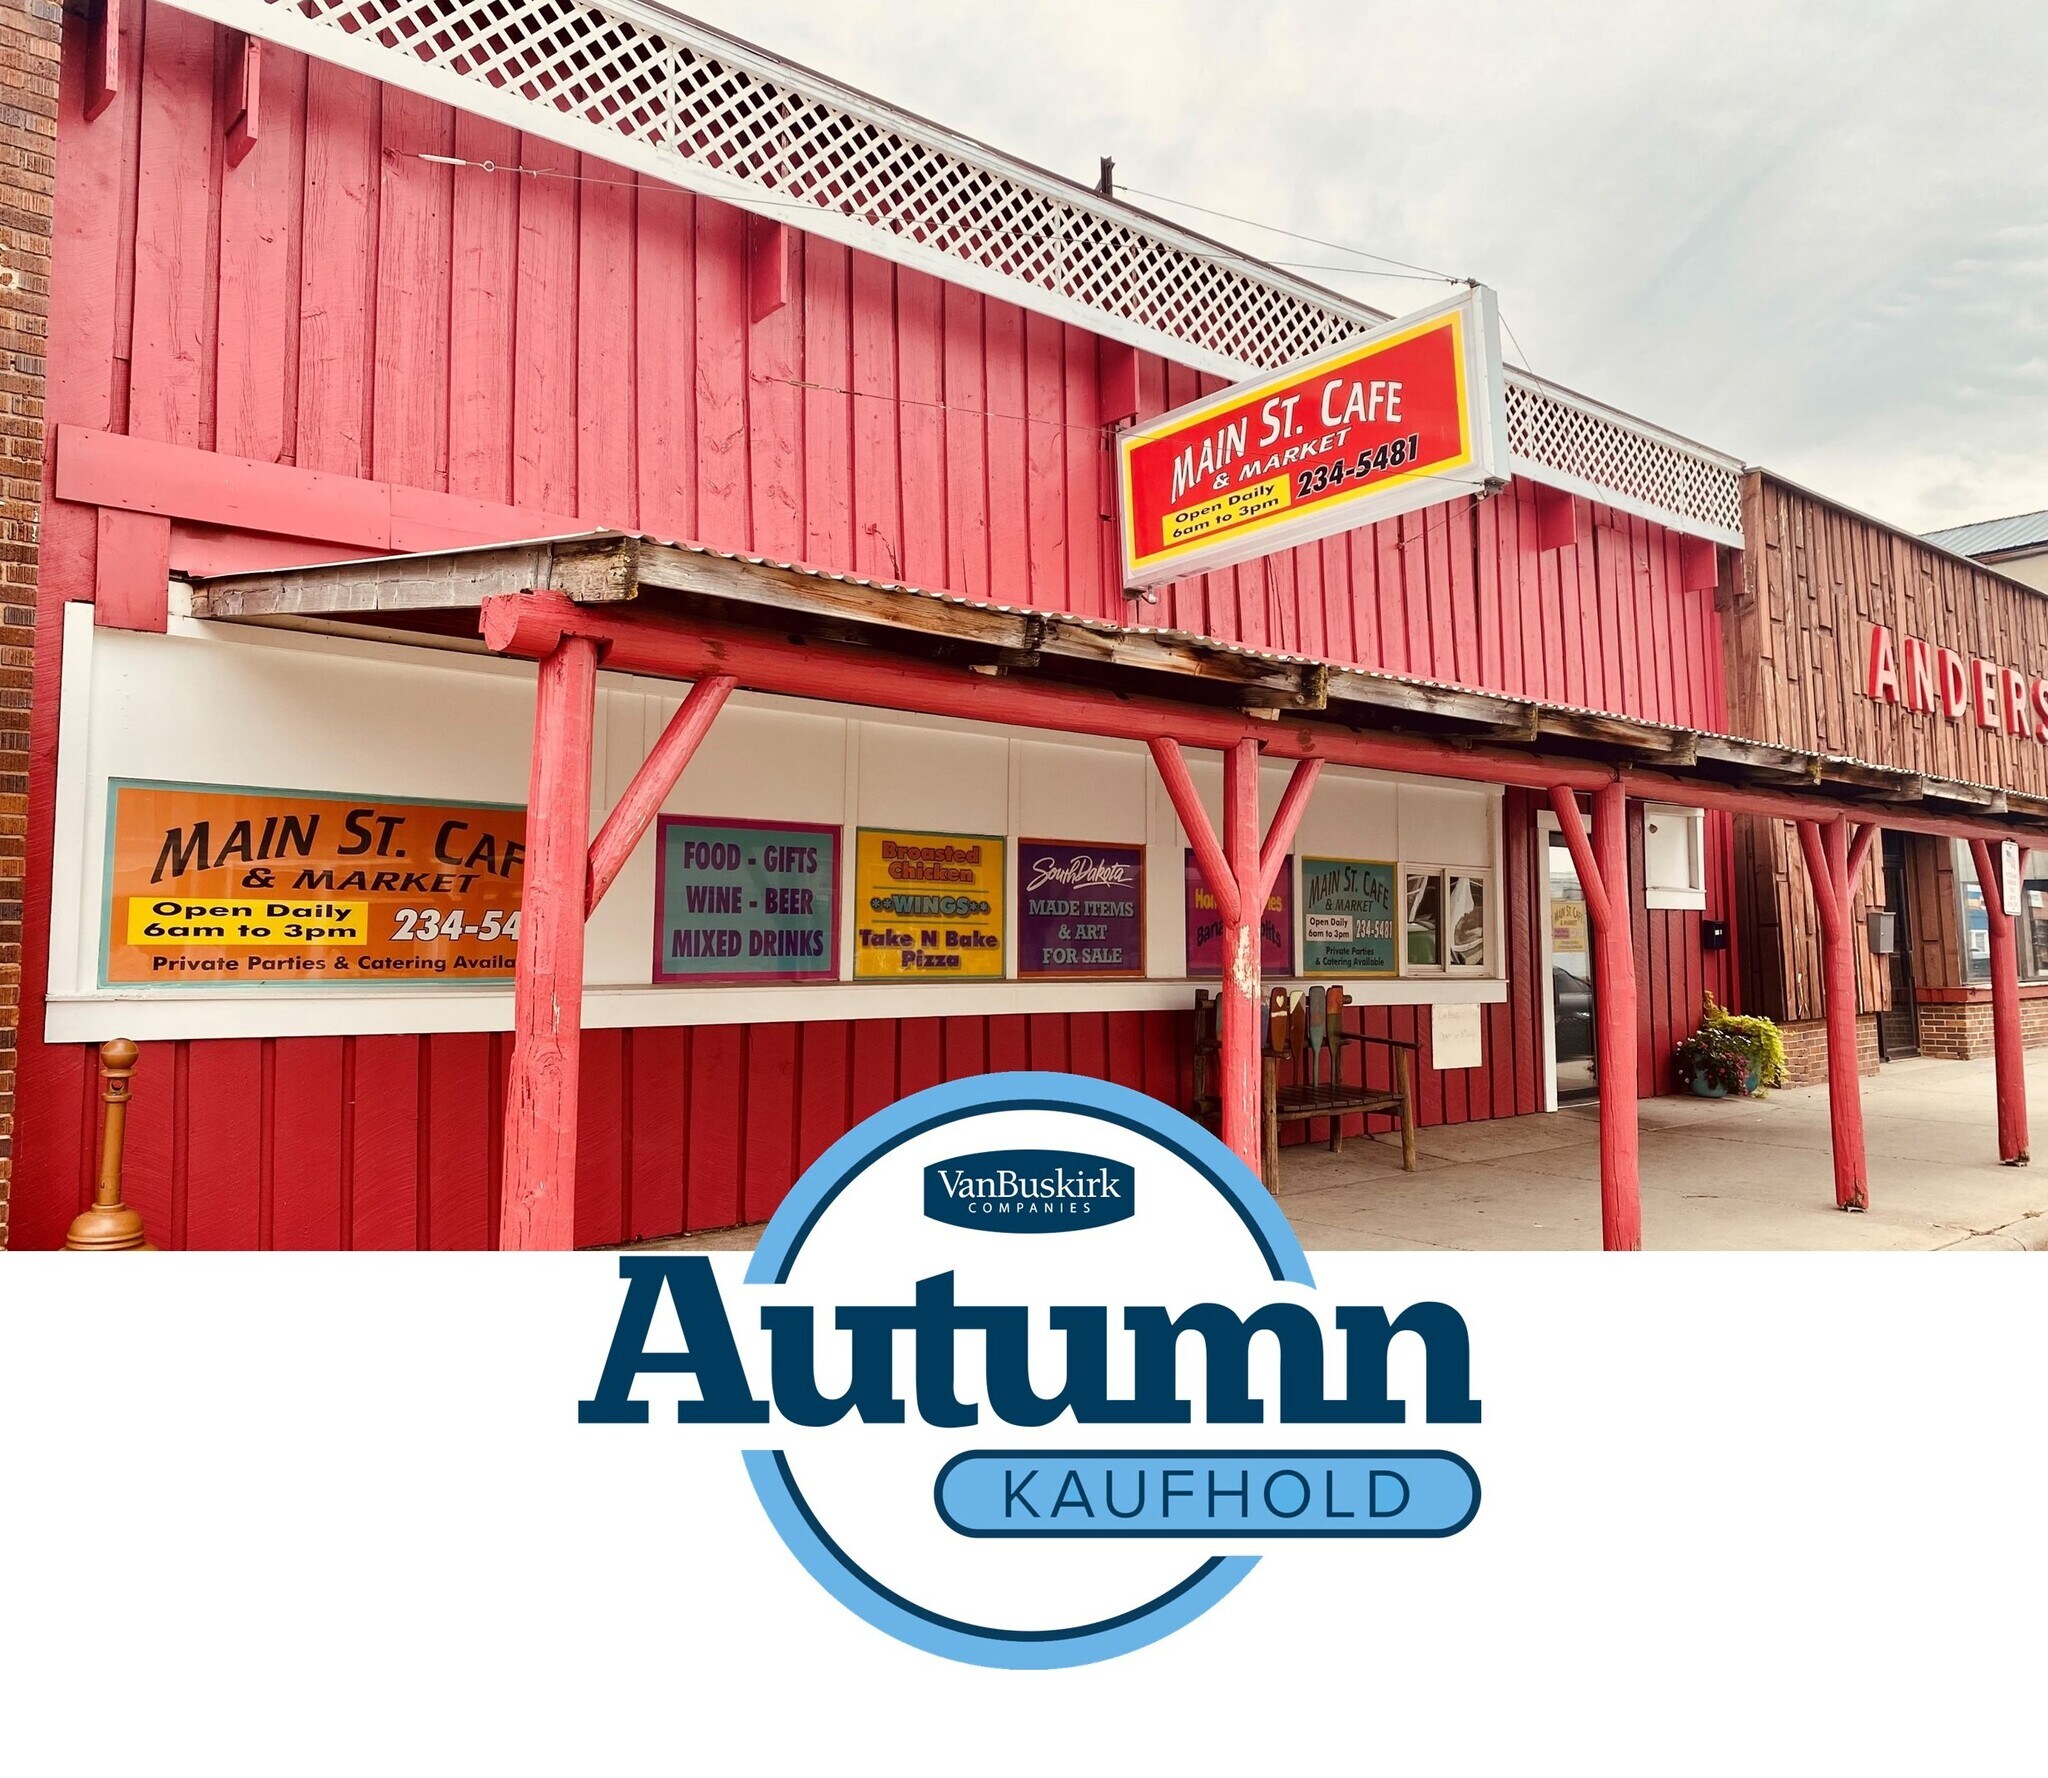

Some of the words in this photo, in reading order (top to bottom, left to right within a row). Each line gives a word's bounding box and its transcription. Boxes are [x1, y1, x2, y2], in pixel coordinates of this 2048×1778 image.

[1170, 416, 1248, 504] MAIN
[1259, 392, 1303, 444] ST.
[1320, 377, 1403, 426] CAFE
[1211, 470, 1231, 491] &
[1239, 426, 1352, 482] MARKET
[1295, 432, 1420, 500] 234-5481
[1175, 503, 1223, 526] Open
[1228, 483, 1275, 507] Daily
[1172, 520, 1210, 539] 6am
[1215, 510, 1233, 523] to
[1238, 497, 1279, 518] 3pm
[150, 814, 320, 884] MAIN
[337, 808, 406, 858] ST.
[433, 819, 525, 878] CAF
[882, 840, 980, 865] Broasted
[683, 841, 741, 871] FOOD
[764, 846, 818, 874] GIFTS
[242, 867, 275, 890] &
[292, 869, 480, 894] MARKET
[888, 862, 975, 884] Chicken
[1309, 870, 1340, 908] MAIN
[1344, 865, 1358, 893] ST.
[1363, 871, 1389, 911] CAFE
[686, 885, 742, 914] WINE
[764, 888, 814, 915] BEER
[1029, 899, 1081, 917] MADE
[1084, 899, 1134, 918] ITEMS
[1325, 898, 1333, 911] &
[1334, 899, 1373, 912] MARKET
[152, 901, 252, 920] Open
[266, 902, 352, 922] Daily
[143, 922, 225, 938] 6am
[238, 923, 271, 938] to
[283, 923, 357, 942] 3pm
[388, 907, 521, 942] 234-54
[1058, 924, 1071, 940] &
[1074, 924, 1108, 940] ART
[1197, 921, 1224, 947] Bana
[1309, 917, 1329, 928] Open
[1330, 917, 1348, 929] Daily
[1355, 919, 1393, 940] 234-5481
[671, 929, 742, 958] MIXED
[749, 929, 824, 957] DRINKS
[859, 929, 913, 948] Take
[921, 930, 937, 948] N
[945, 930, 998, 948] Bake
[1308, 929, 1324, 938] 6am
[1325, 929, 1333, 938] to
[1334, 930, 1350, 940] 3pm
[901, 950, 960, 970] Pizza
[1042, 948, 1078, 964] FOR
[1081, 947, 1123, 964] SALE
[1325, 946, 1350, 956] Private
[1351, 946, 1375, 956] Parties
[153, 956, 239, 972] Private
[247, 955, 326, 971] Parties
[333, 956, 350, 970] &
[357, 955, 446, 974] Catering
[453, 955, 515, 970] Availa
[1315, 957, 1321, 966] &
[1322, 957, 1352, 968] Catering
[1353, 957, 1385, 967] Available
